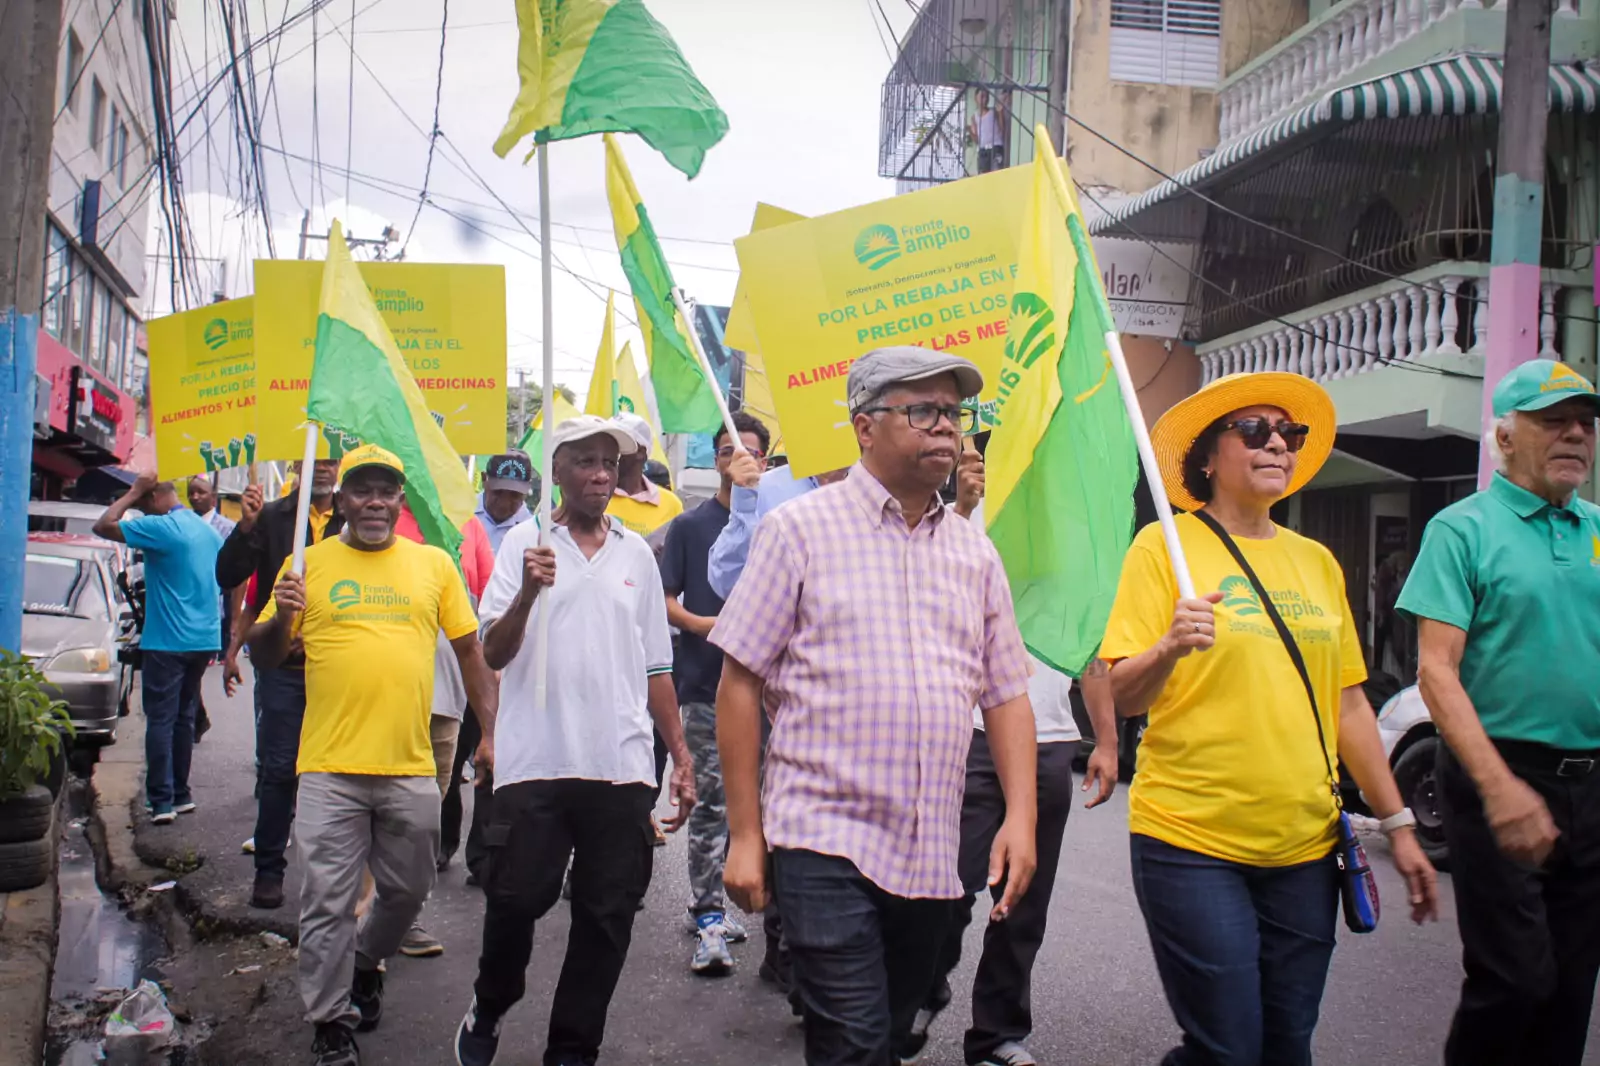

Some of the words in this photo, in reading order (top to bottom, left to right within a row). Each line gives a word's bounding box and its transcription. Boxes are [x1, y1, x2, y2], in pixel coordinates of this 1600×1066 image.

[901, 219, 943, 236] Frente
[905, 225, 970, 253] amplio
[895, 267, 946, 284] Democracia
[375, 288, 407, 298] Frente
[818, 305, 858, 327] POR
[863, 299, 888, 316] LA
[893, 276, 975, 309] REBAJA
[979, 269, 1005, 286] EN
[376, 297, 424, 315] amplio
[857, 312, 934, 344] PRECIO
[939, 304, 966, 323] DE
[970, 294, 1007, 315] LOS
[425, 339, 442, 350] EN
[447, 339, 464, 350] EL
[931, 330, 971, 351] LAS
[204, 370, 216, 381] LA
[221, 361, 255, 377] REBAJ
[413, 358, 440, 370] LOS
[199, 381, 240, 398] PRECIO
[417, 378, 496, 389] MEDICINAS
[161, 403, 223, 424] ALIMENTOS
[226, 398, 233, 409] Y
[364, 585, 394, 594] Frente
[1266, 589, 1300, 600] rente
[364, 593, 410, 607] amplio
[1274, 600, 1324, 620] mplio
